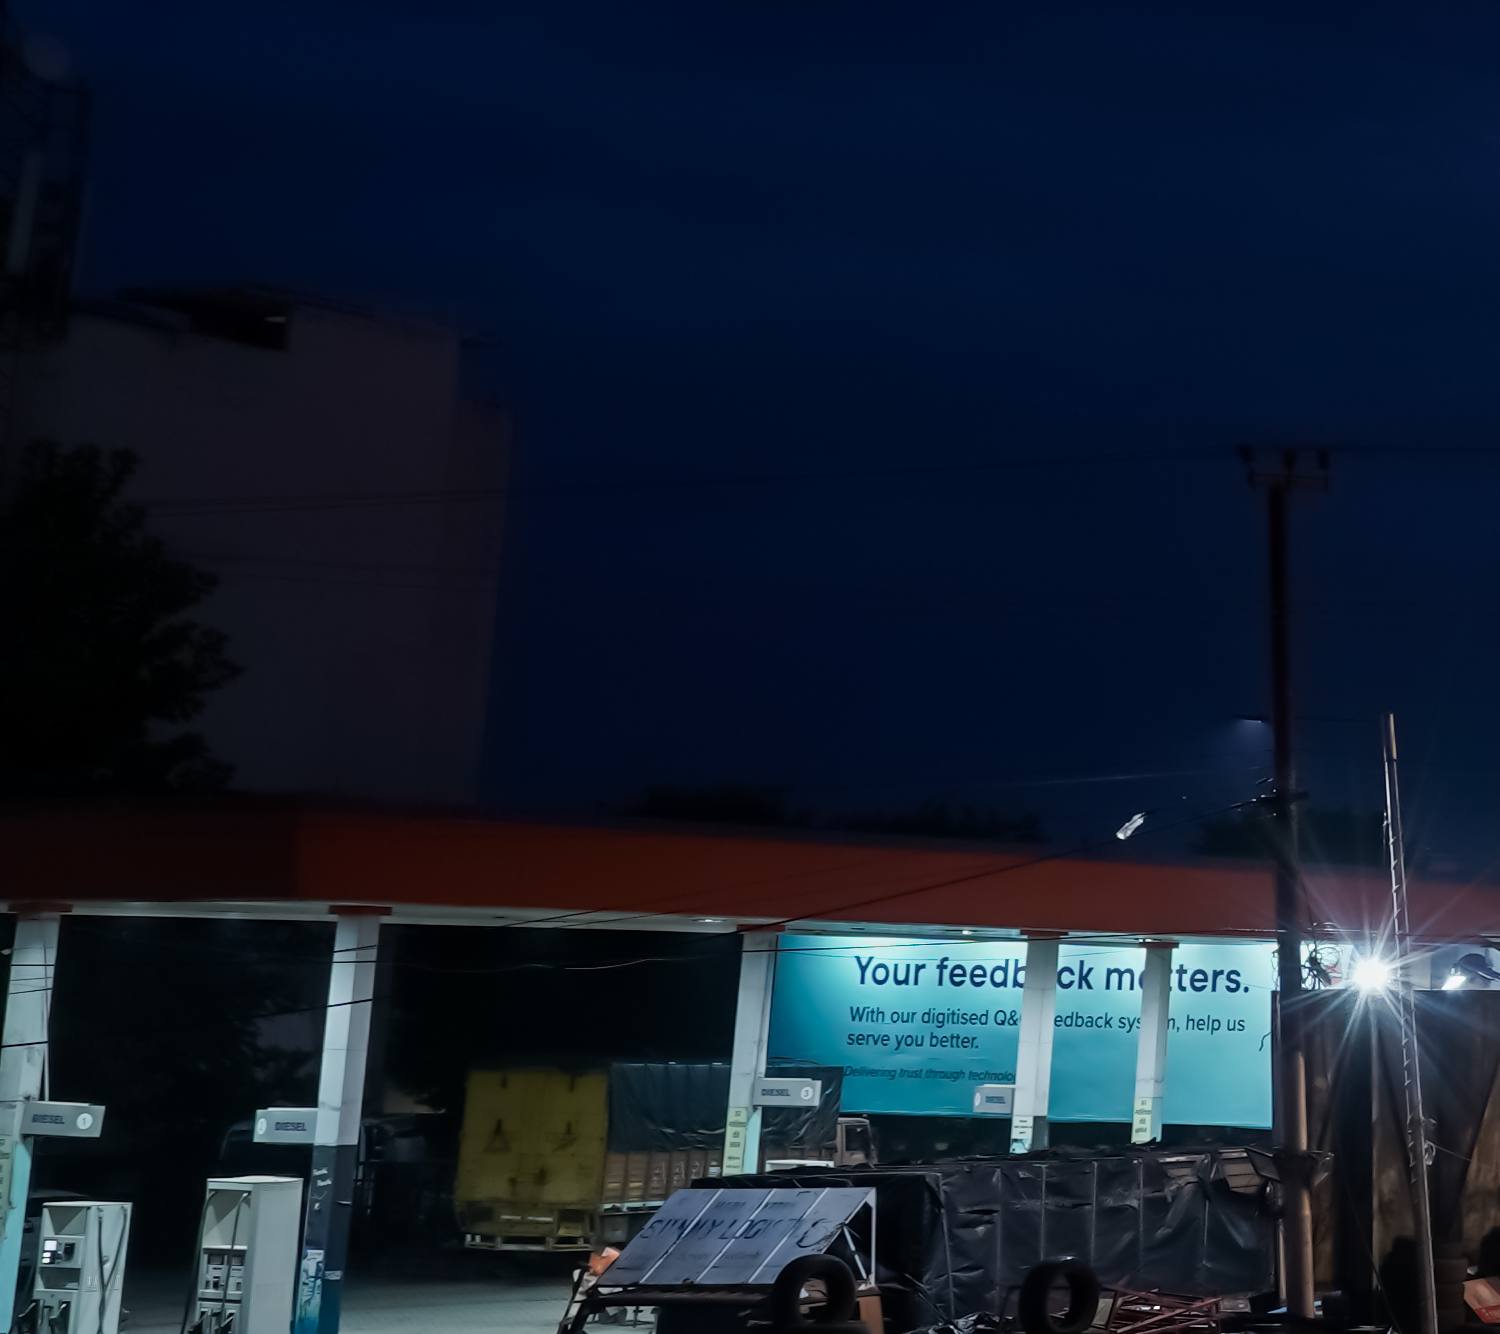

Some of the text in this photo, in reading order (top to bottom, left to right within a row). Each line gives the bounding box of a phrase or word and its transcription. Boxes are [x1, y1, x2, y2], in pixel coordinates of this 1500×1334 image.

[853, 955, 1250, 994] Your feedbck mters.
[849, 1005, 885, 1024] With
[890, 1010, 917, 1024] our
[920, 1008, 989, 1029] digitised
[993, 1009, 1022, 1026] Q&
[1053, 1011, 1113, 1029] edback
[1185, 1014, 1222, 1036] help
[1226, 1017, 1246, 1033] us
[846, 1031, 980, 1051] serve you better.
[843, 1065, 898, 1081] Delivering
[899, 1067, 924, 1079] trust
[925, 1067, 966, 1082] through
[31, 1113, 65, 1125] DIESEL
